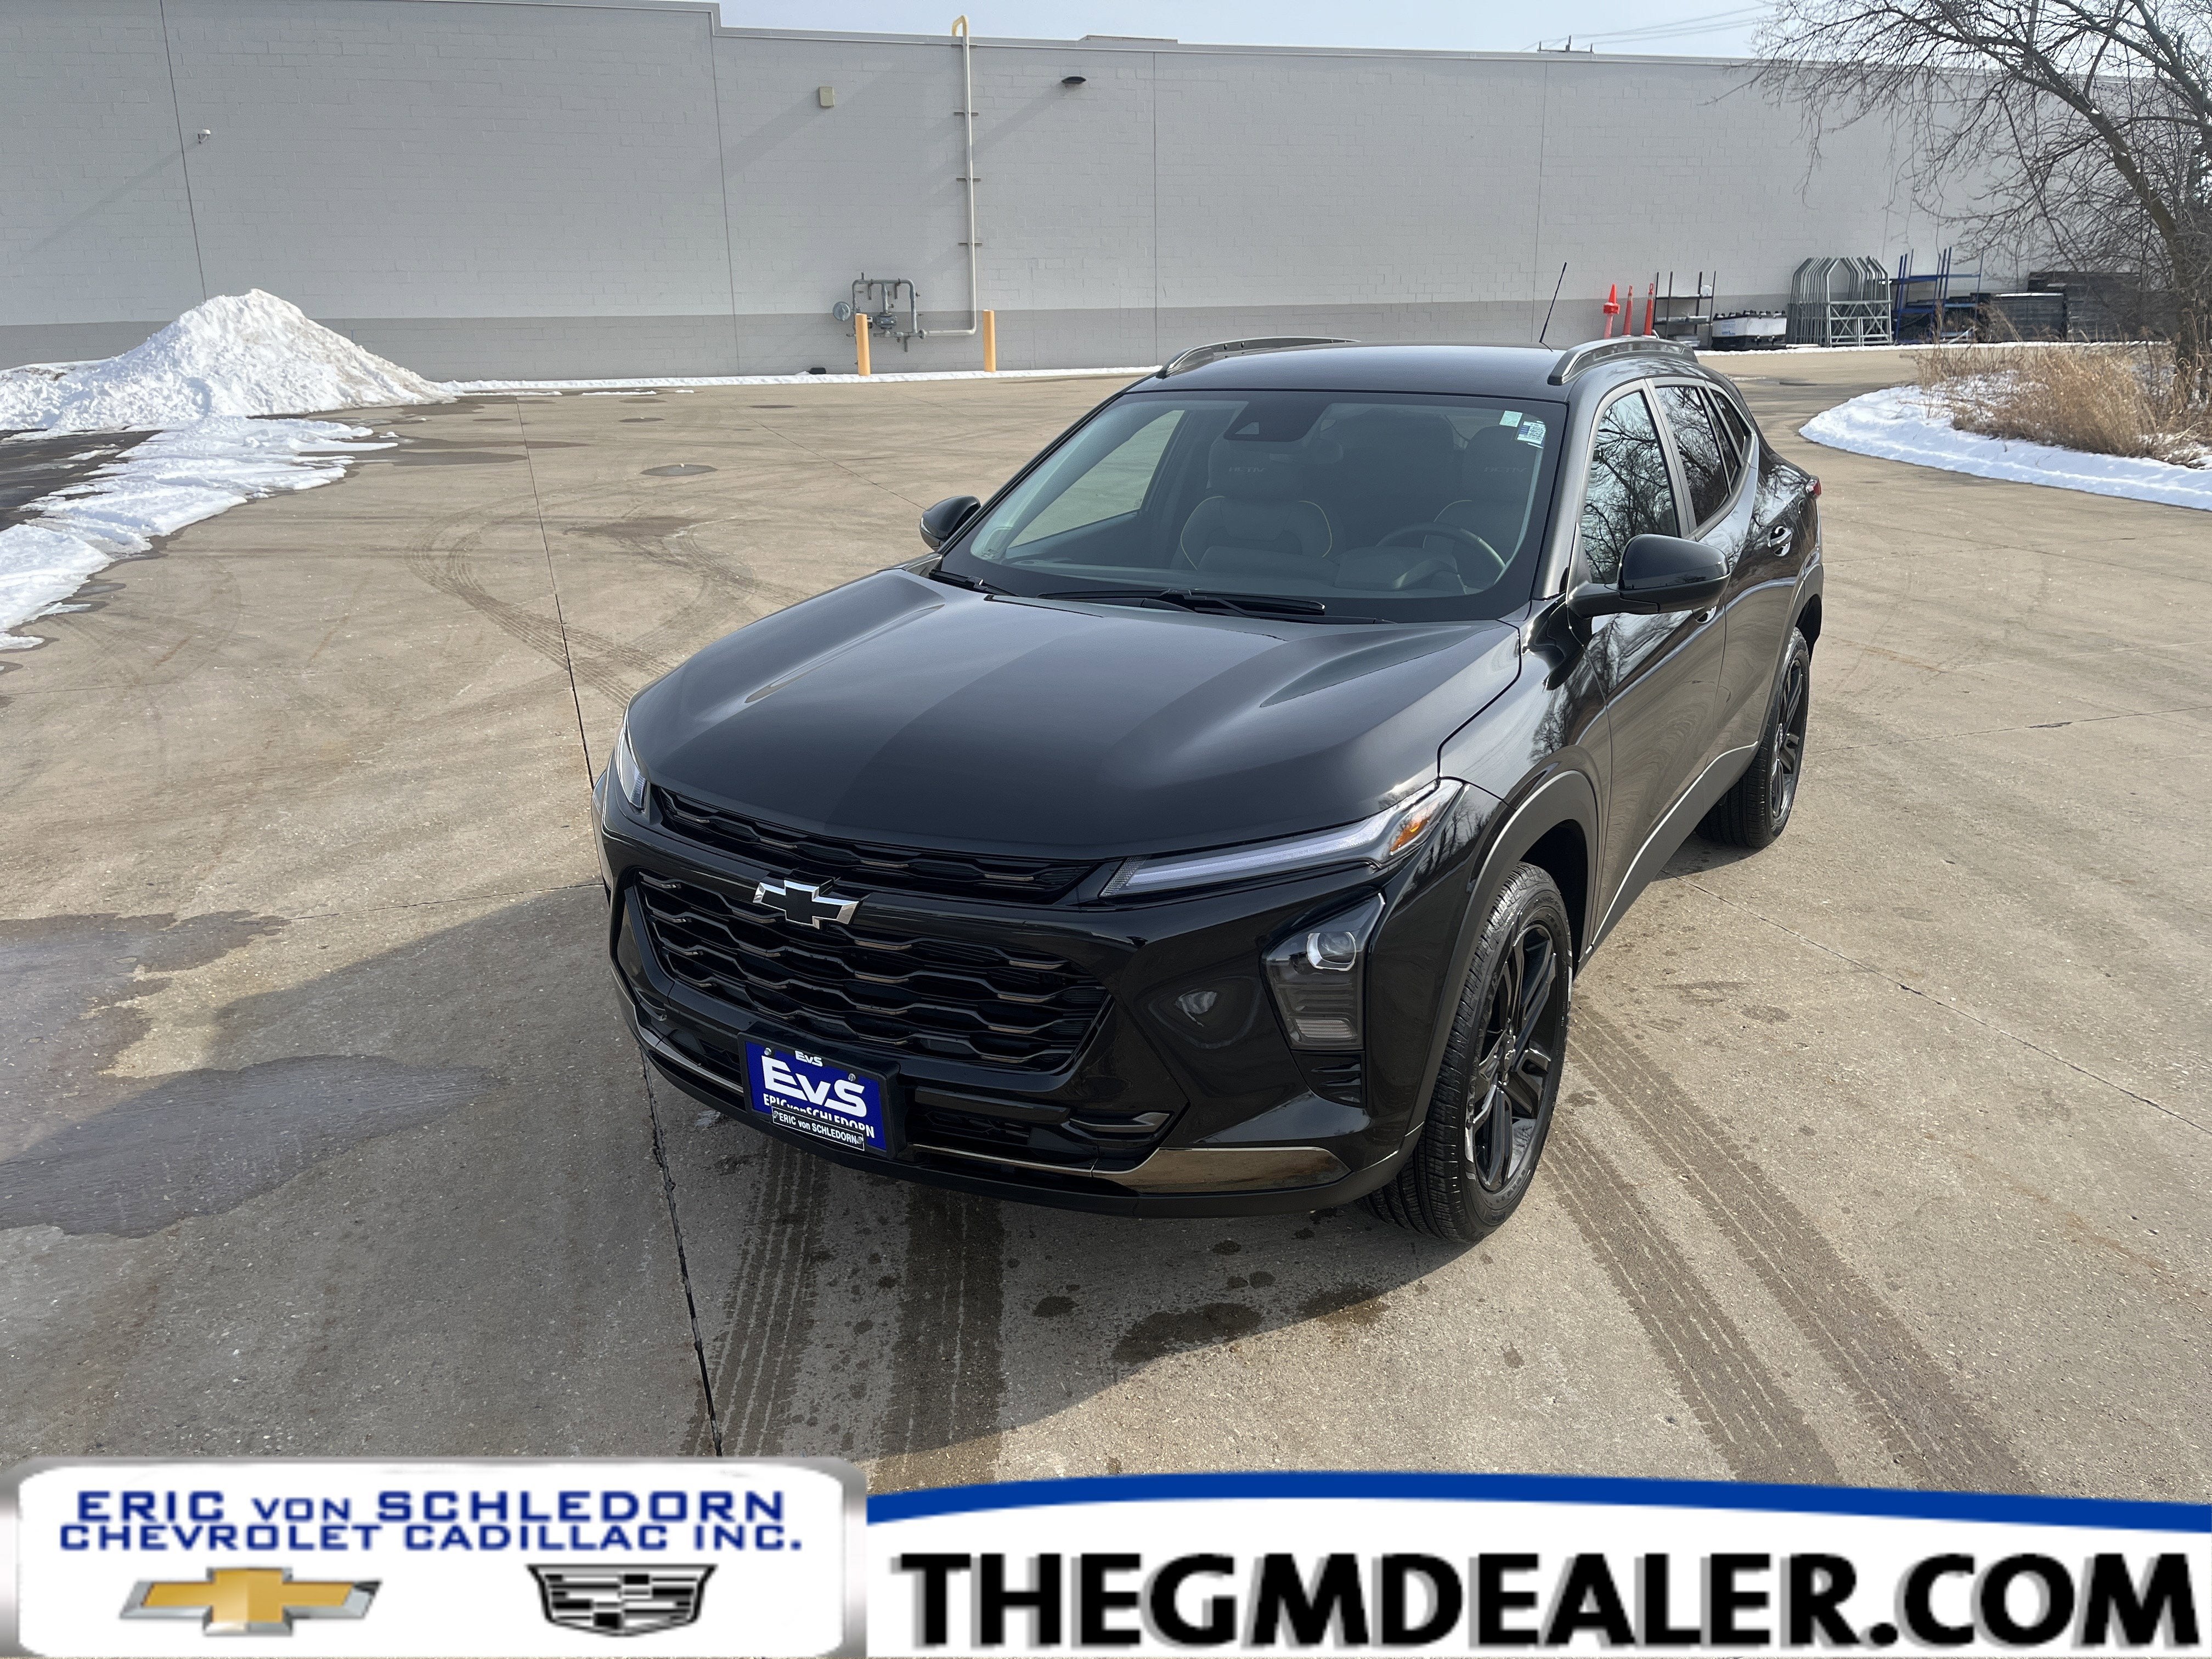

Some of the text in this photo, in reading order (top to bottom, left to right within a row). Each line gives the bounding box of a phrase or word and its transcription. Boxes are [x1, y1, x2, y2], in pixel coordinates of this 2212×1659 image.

[779, 1112, 857, 1144] ERIC von SCHLEDORN
